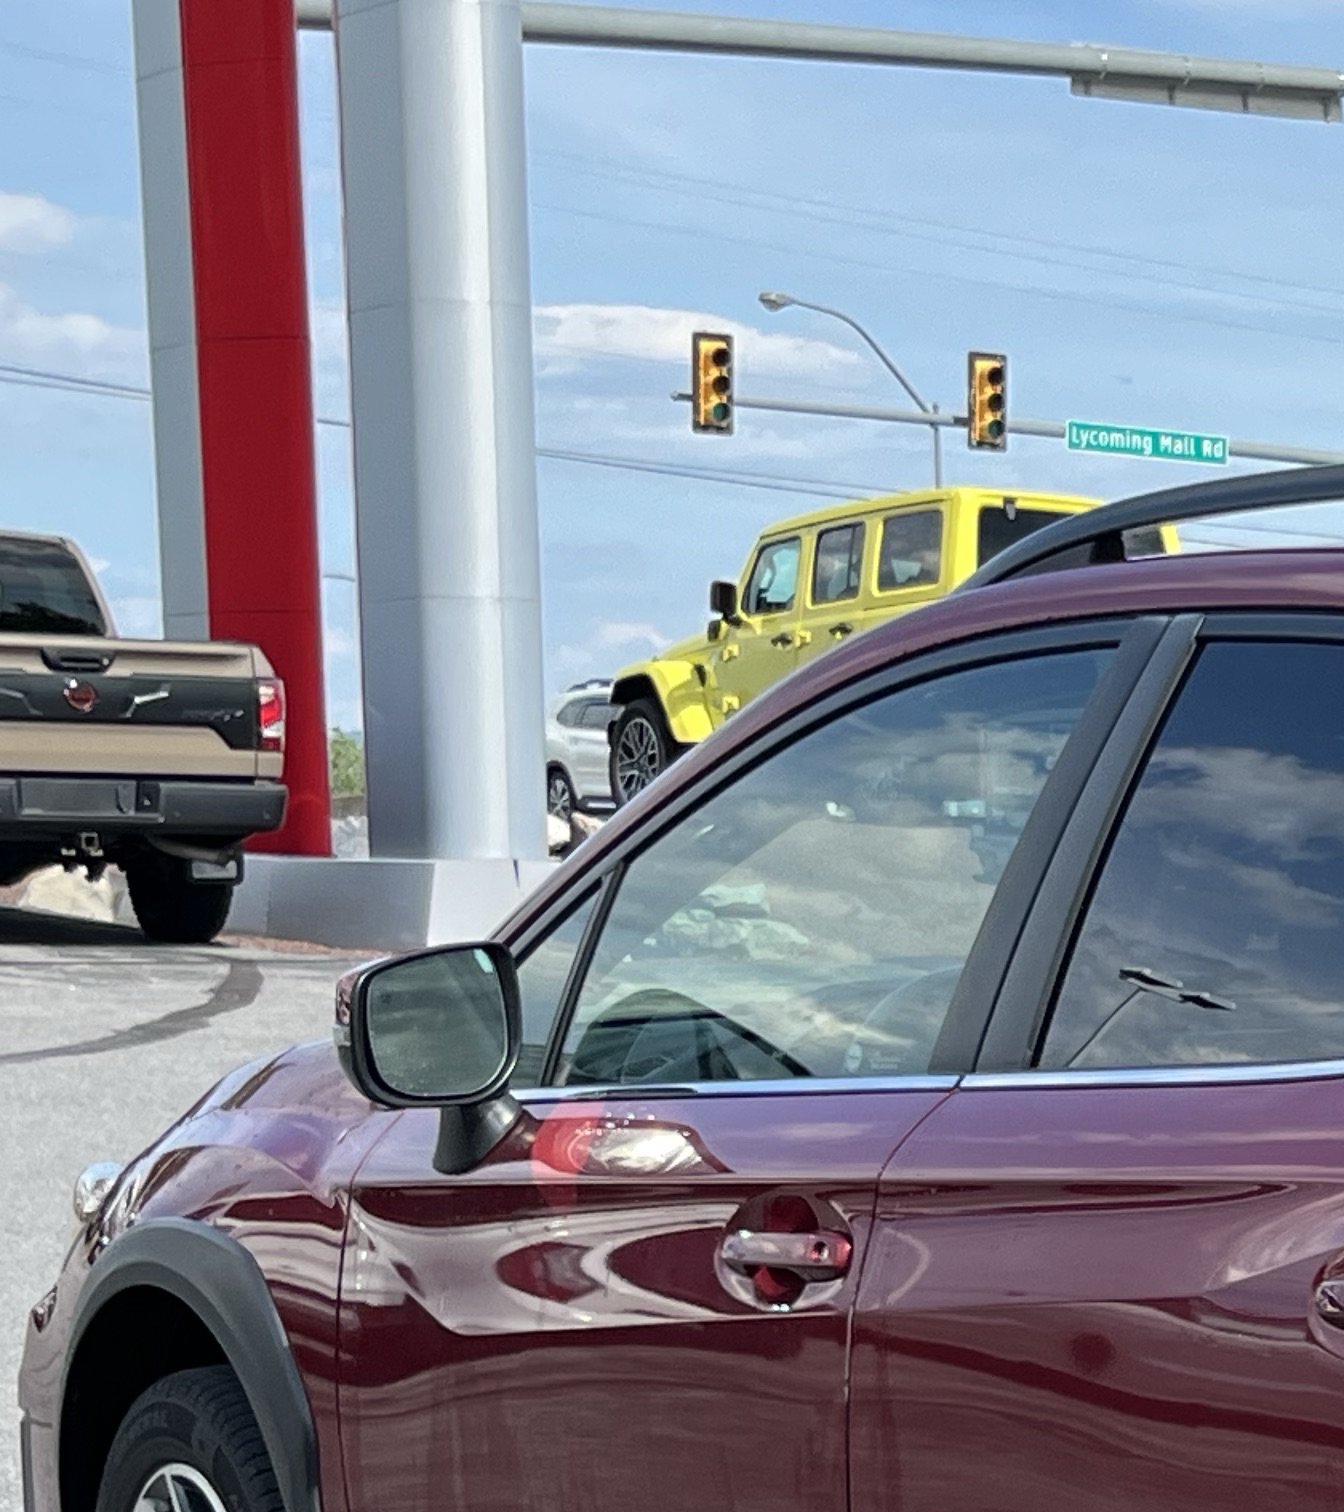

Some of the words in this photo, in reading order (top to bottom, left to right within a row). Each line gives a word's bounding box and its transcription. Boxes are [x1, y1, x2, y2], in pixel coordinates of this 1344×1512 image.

[1071, 426, 1153, 456] Lycoming
[1160, 435, 1196, 457] Mall
[1202, 439, 1223, 458] Rd
